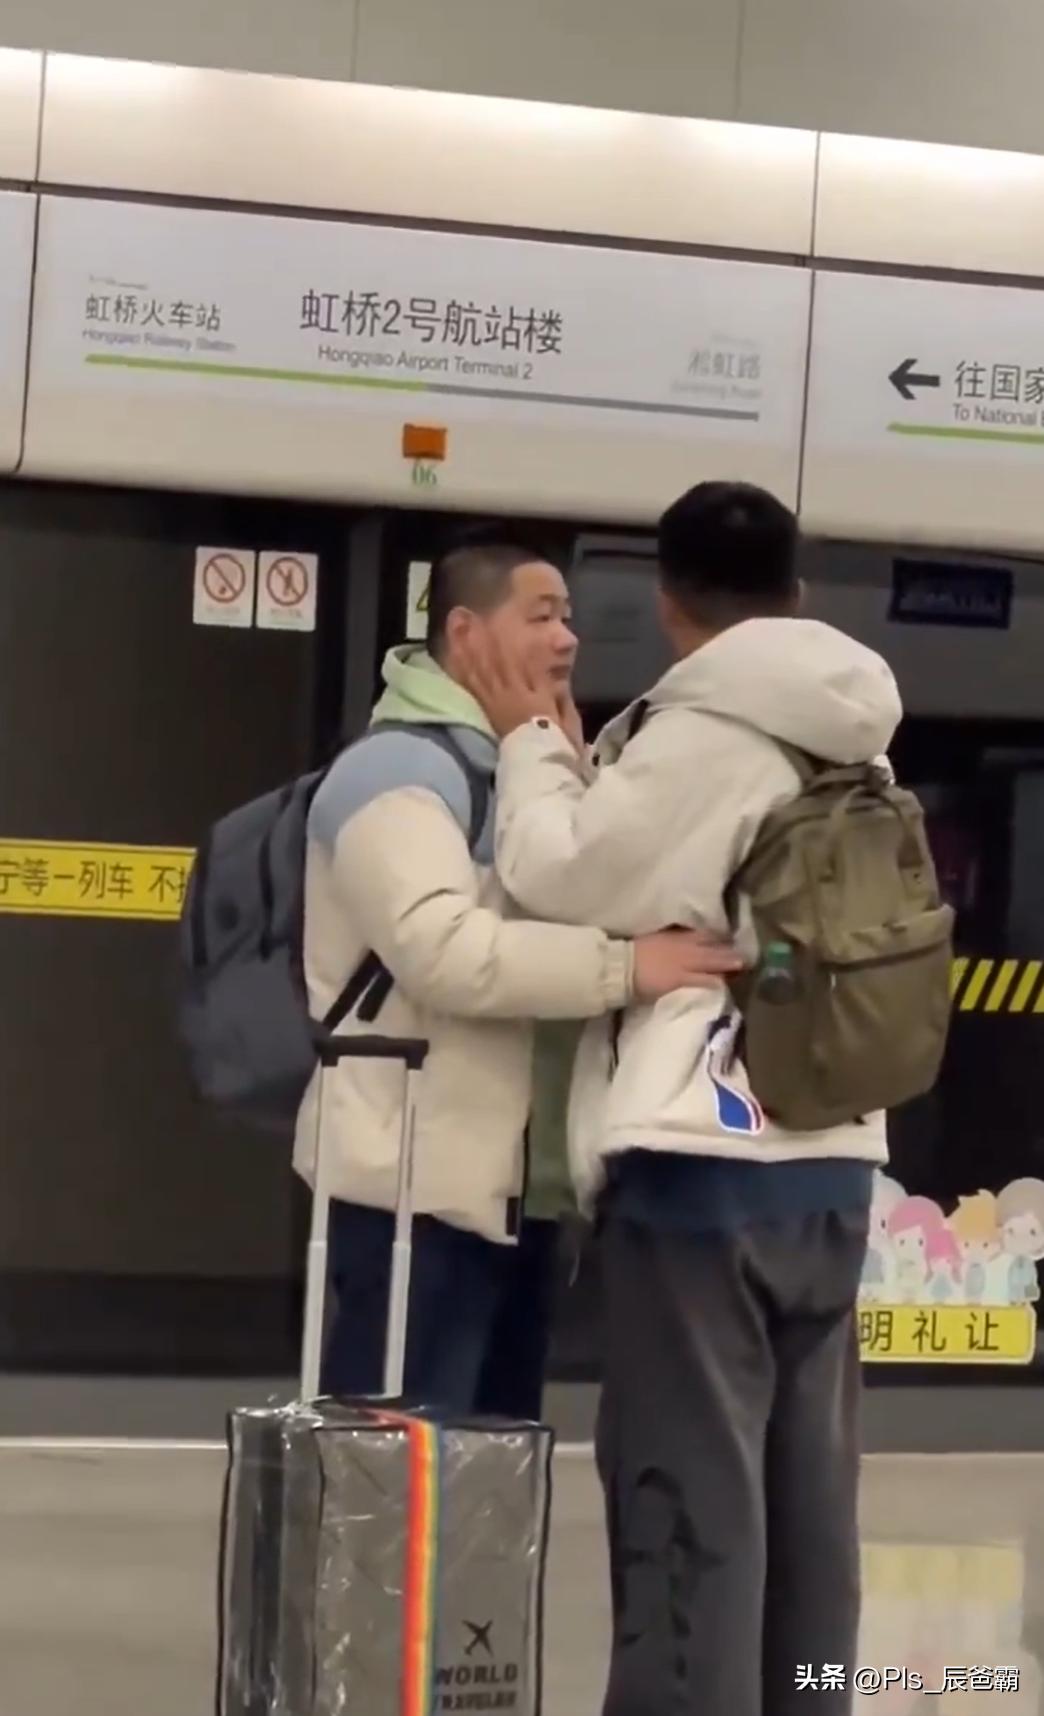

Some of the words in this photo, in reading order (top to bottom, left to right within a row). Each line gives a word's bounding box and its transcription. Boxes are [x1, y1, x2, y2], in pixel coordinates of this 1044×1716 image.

[85, 294, 222, 331] 虹桥火车站
[299, 289, 563, 354] 虹桥2号航站楼
[318, 345, 394, 368] Hongqiao
[397, 350, 449, 372] Airport
[455, 356, 518, 378] Terminal
[523, 362, 533, 380] 2
[952, 403, 970, 421] To
[974, 405, 1037, 426] National
[435, 1663, 519, 1686] WORLD
